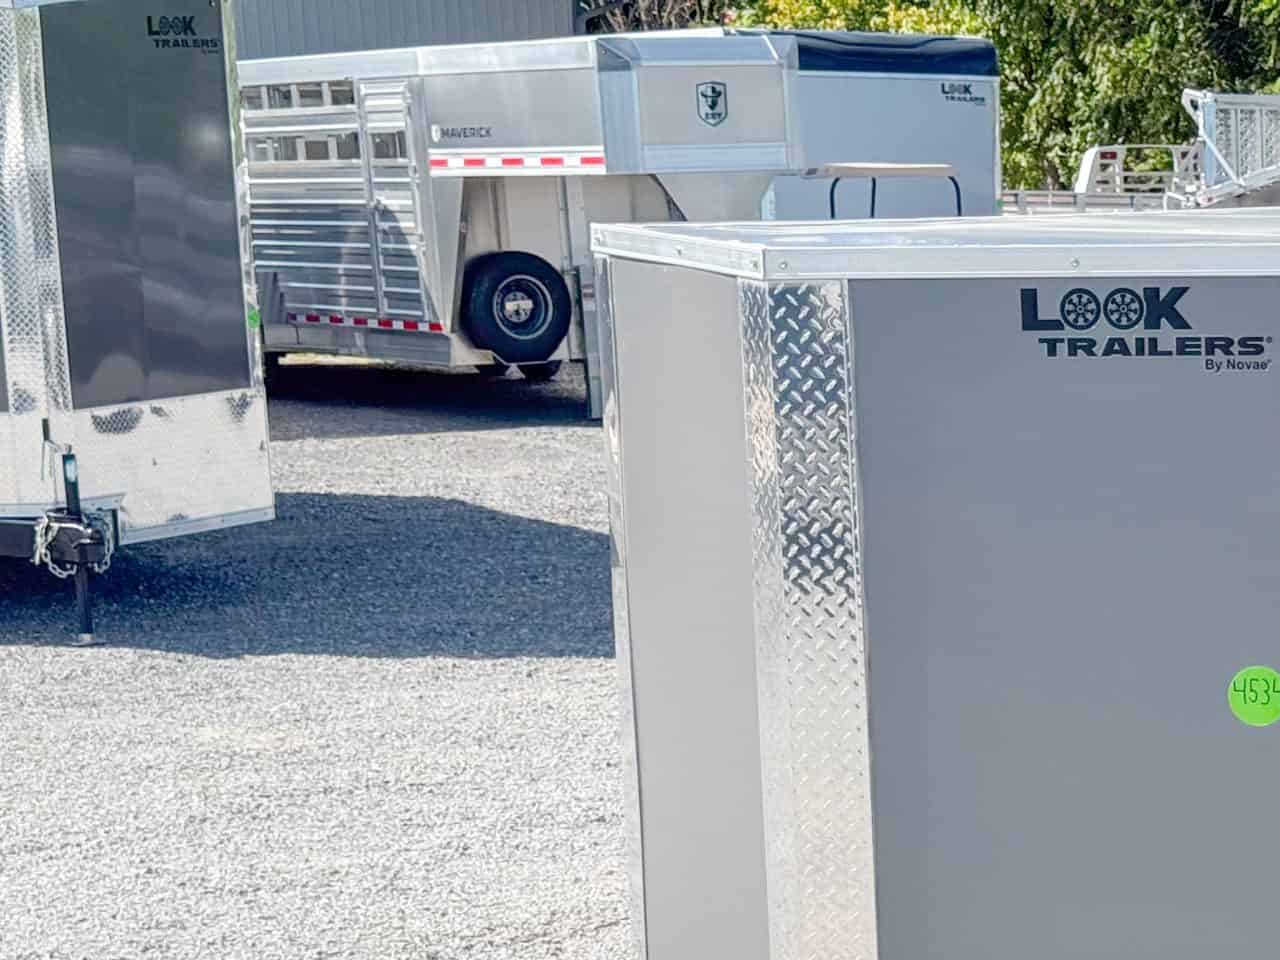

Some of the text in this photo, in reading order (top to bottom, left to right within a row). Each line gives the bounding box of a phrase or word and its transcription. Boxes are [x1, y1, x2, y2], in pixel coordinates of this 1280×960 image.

[146, 15, 197, 36] LOOK
[153, 39, 219, 48] TRAILERS
[441, 127, 493, 138] MAVERICK
[1020, 286, 1192, 331] LOOK
[1205, 359, 1272, 373] By Novae
